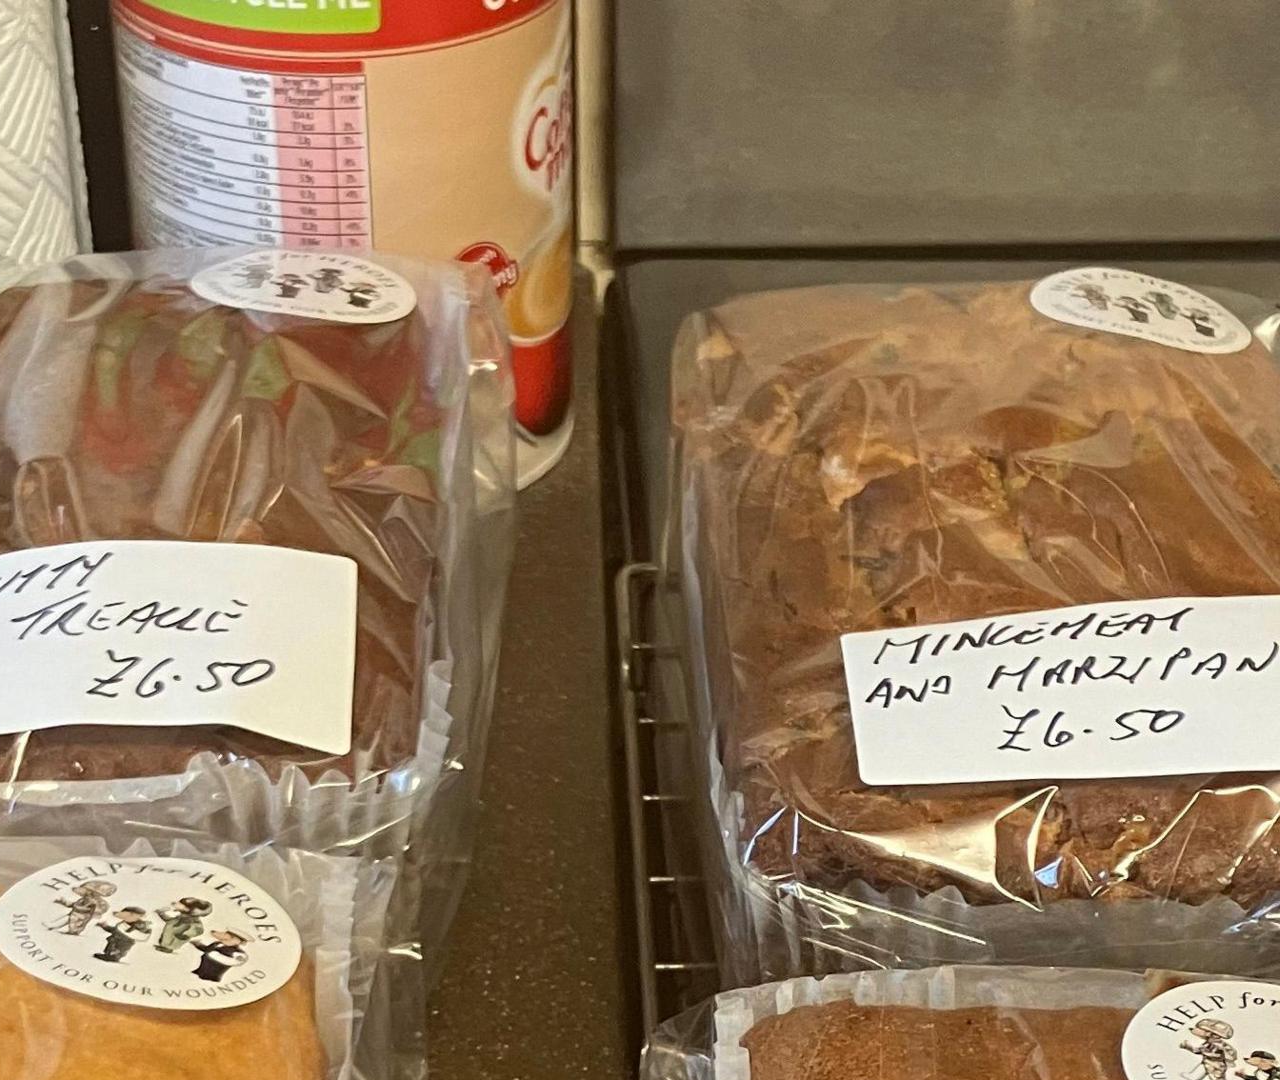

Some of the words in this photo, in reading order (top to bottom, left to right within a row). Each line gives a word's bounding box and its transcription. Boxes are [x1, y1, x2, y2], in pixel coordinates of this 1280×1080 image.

[11, 590, 248, 640] TREACLE
[873, 607, 1193, 665] MINCEMEAT
[865, 674, 951, 708] AND
[987, 642, 1279, 693] MARZIPAN
[40, 862, 123, 892] HELP
[134, 863, 183, 874] for
[189, 871, 282, 944] HEROES
[11, 913, 53, 963] SUPPORT
[52, 963, 91, 984] FOR
[102, 979, 153, 997] OUR
[162, 969, 268, 999] WOUNDED
[1156, 994, 1225, 1033] HELP
